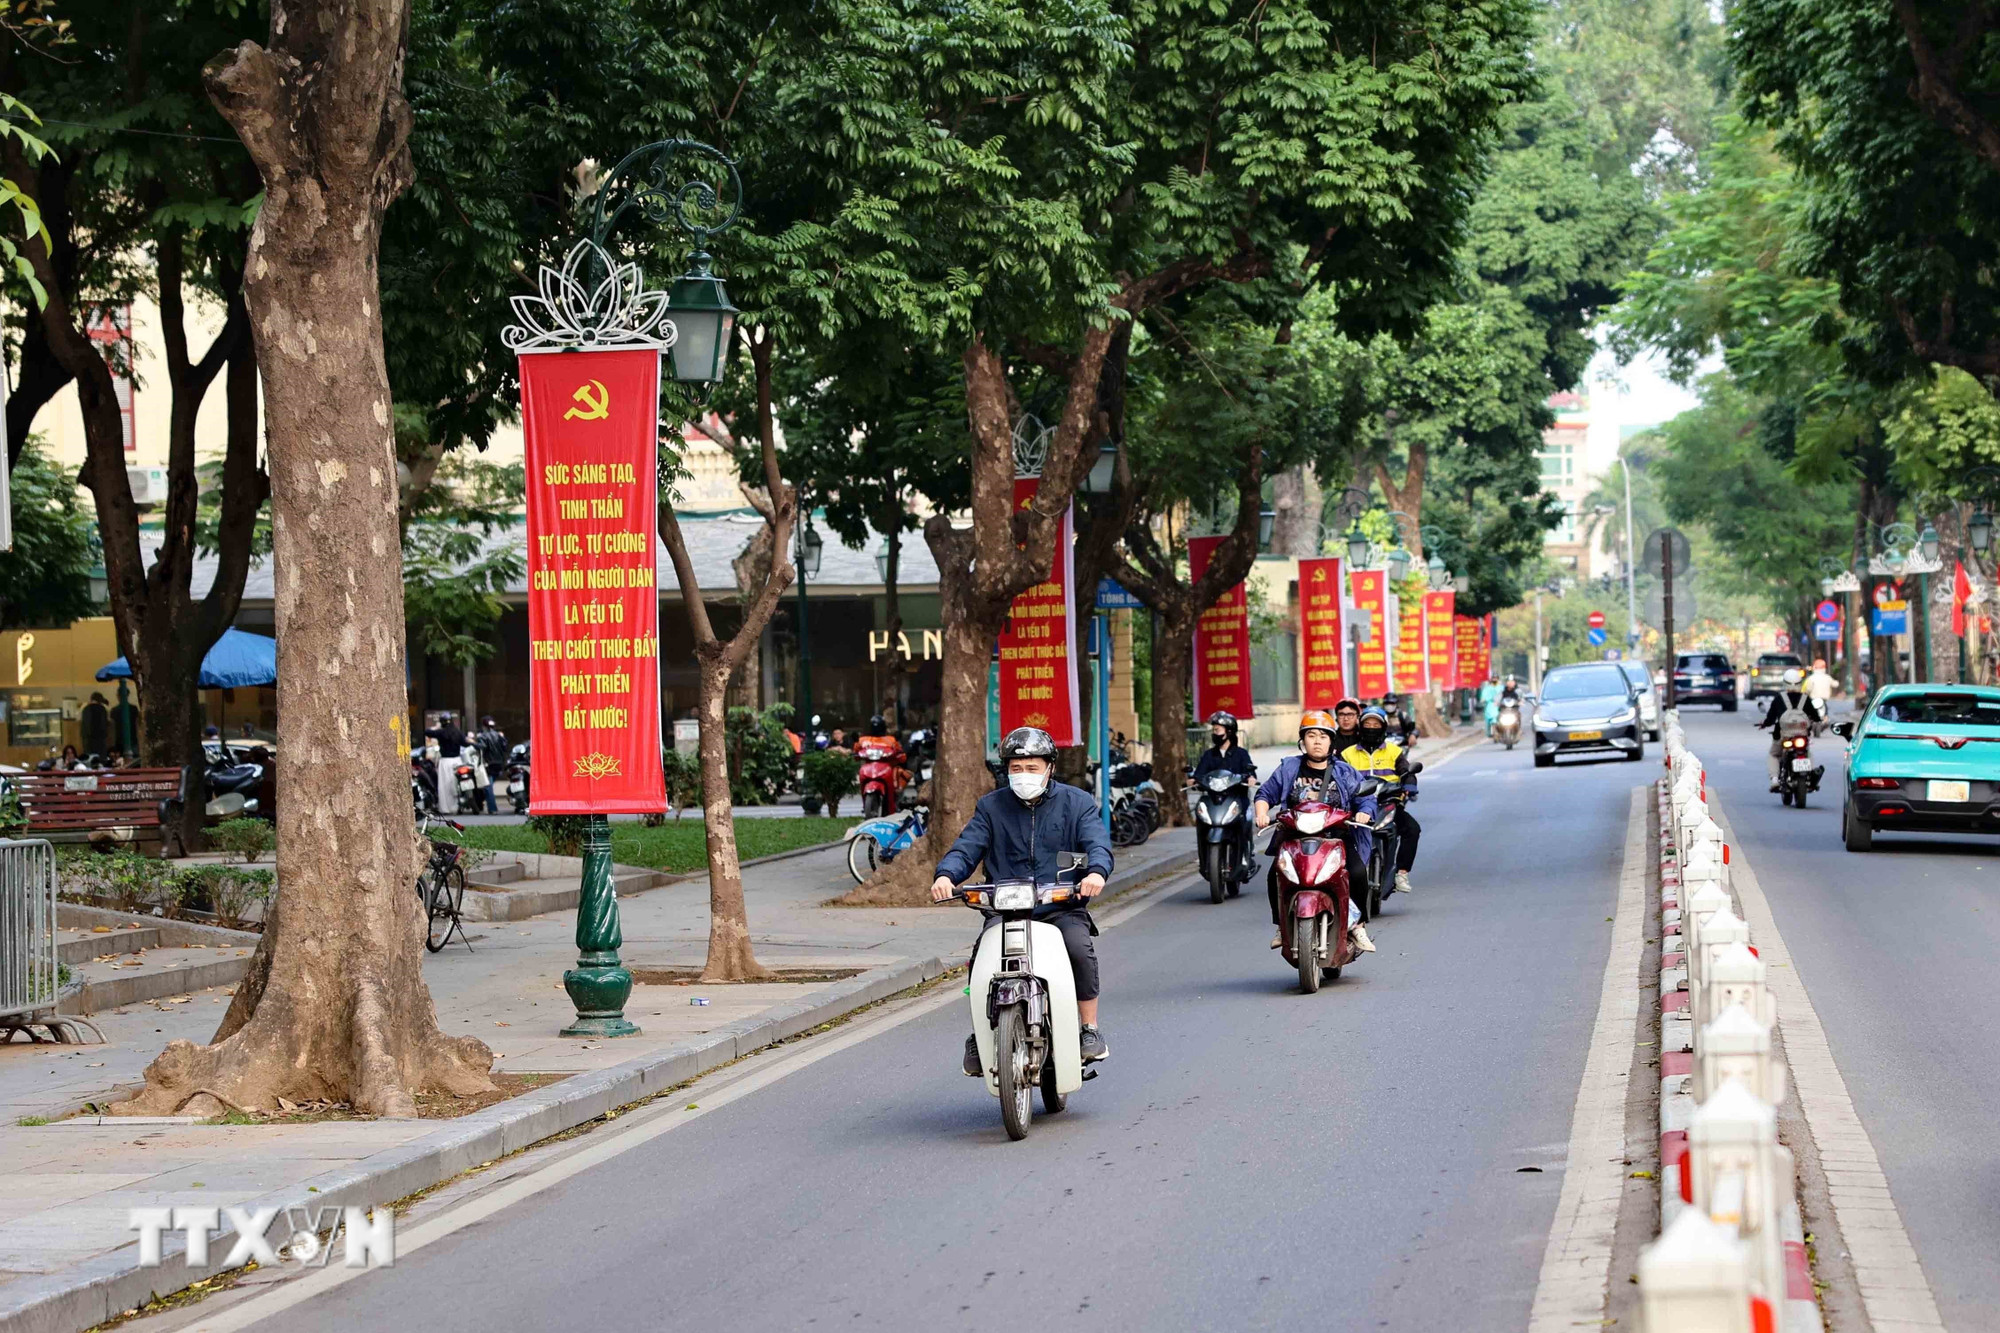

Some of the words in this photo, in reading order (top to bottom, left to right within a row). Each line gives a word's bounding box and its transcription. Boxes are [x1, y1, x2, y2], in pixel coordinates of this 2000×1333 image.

[545, 461, 570, 485] SỨC
[573, 460, 607, 485] SÁNG
[610, 463, 636, 488] TẠO,
[560, 499, 588, 519] TINH
[591, 492, 623, 519] THẦN
[538, 533, 555, 560] TỰ
[556, 533, 583, 560] LỰC,
[586, 532, 602, 559] TỰ
[605, 529, 646, 554] CƯỜNG
[534, 563, 557, 591] CỦA
[560, 562, 584, 590] MỖI
[587, 564, 625, 589] NGƯỜI
[629, 564, 654, 588] DÂN
[564, 601, 579, 624] LÀ
[582, 598, 605, 624] YẾU
[608, 596, 623, 624] TỐ
[532, 640, 562, 660] THEN
[566, 632, 596, 659] CHỐT
[600, 634, 630, 658] THÚC
[561, 671, 591, 694] PHÁT
[594, 665, 630, 694] TRIỂN
[564, 703, 586, 729] ĐẤT
[590, 705, 628, 729] NƯỚC!
